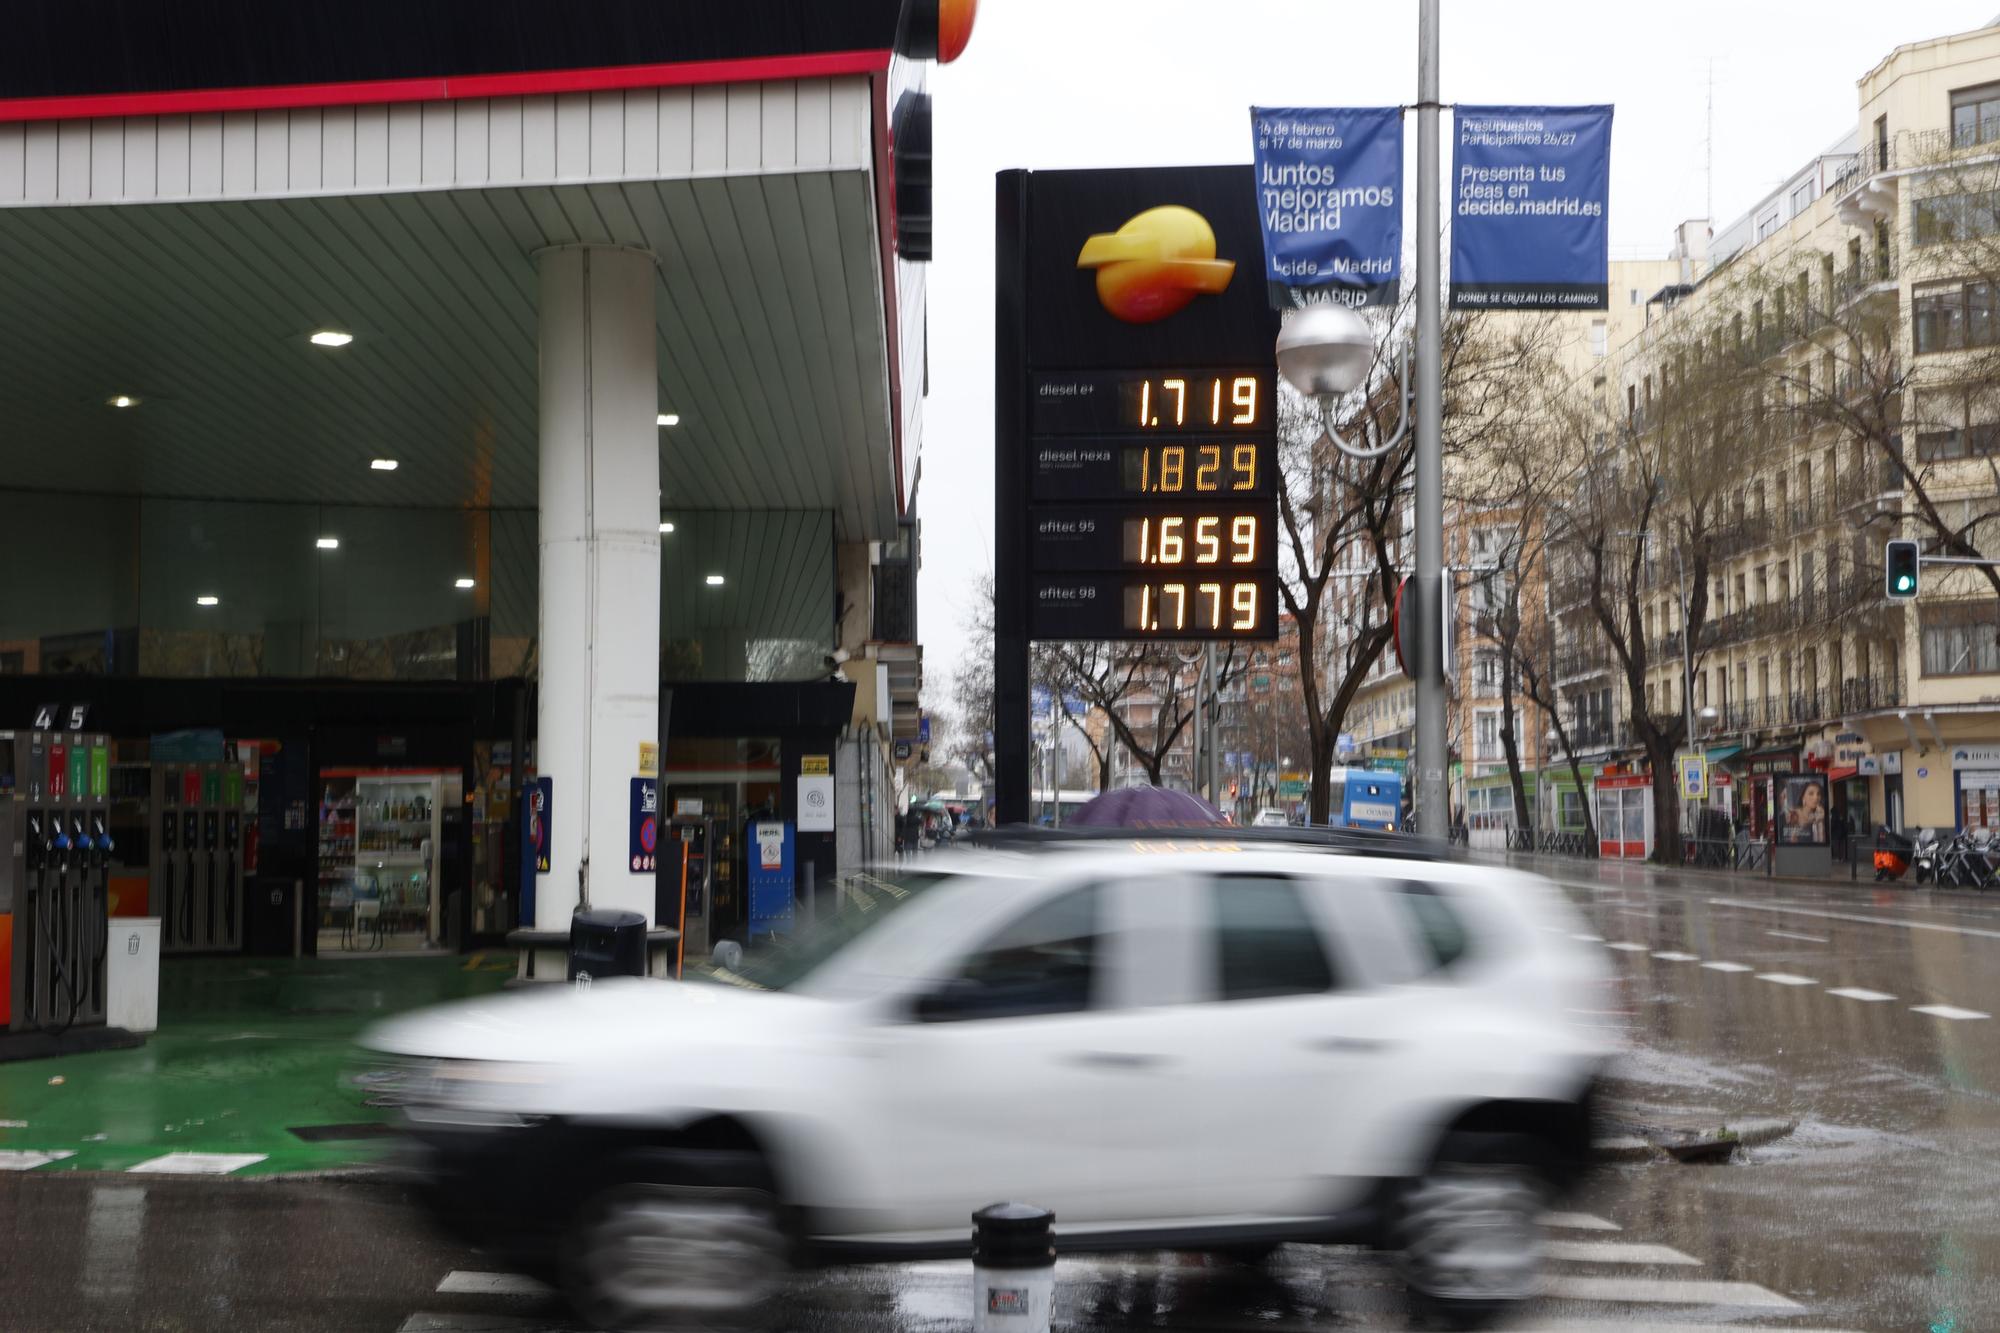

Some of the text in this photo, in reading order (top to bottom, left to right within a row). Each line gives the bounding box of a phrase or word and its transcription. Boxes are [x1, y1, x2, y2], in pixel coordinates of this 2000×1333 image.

[1273, 121, 1289, 136] de
[1292, 121, 1335, 136] febrero
[1461, 119, 1544, 133] Presupuestos
[1259, 136, 1343, 150] al 17 de marzo
[1461, 132, 1577, 147] Participativos 26/27
[1262, 160, 1335, 186] Juntos
[1461, 164, 1566, 183] Presenta tus
[1459, 182, 1529, 199] ideas en
[1458, 197, 1602, 216] decide.madrid.es
[1306, 287, 1368, 308] MADRID
[1457, 292, 1599, 306] DONDE SE CRUZAN LOS CAMINOS
[1040, 383, 1077, 396] diesel
[1141, 377, 1257, 427] 1.719
[1040, 444, 1257, 493] diesel nexa 1.829
[1040, 516, 1257, 564] efitec 95 1.659
[1040, 582, 1257, 631] efitec 98 1.779
[35, 705, 84, 730] 4 5
